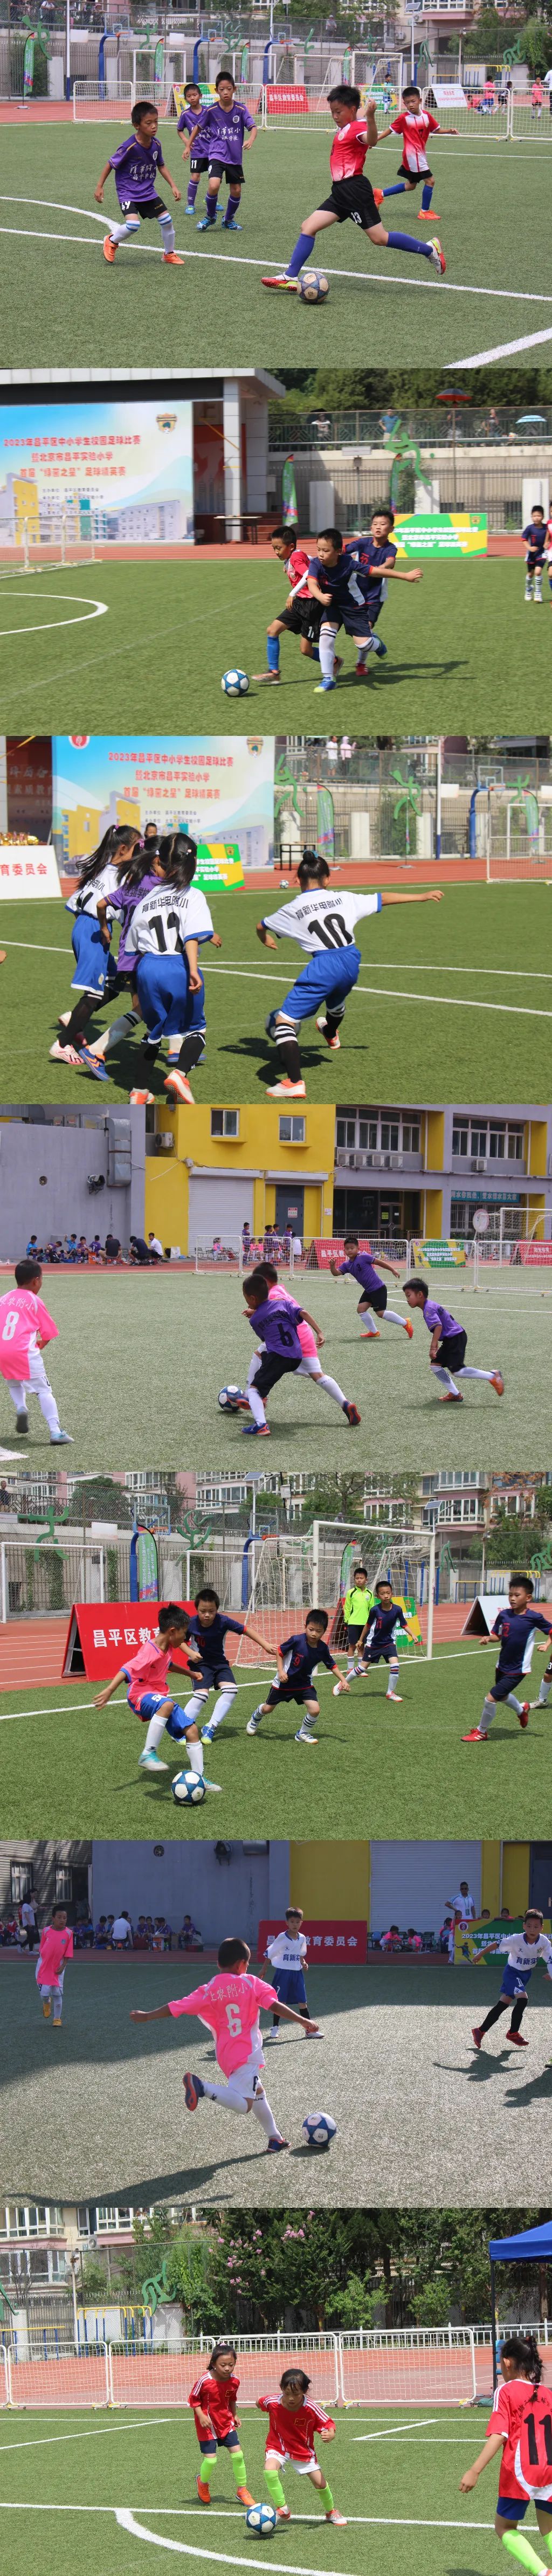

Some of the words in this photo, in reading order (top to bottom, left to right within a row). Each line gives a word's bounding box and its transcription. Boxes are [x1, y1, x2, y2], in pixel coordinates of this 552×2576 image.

[4, 435, 141, 446] 2023年昌平区中小学生校园足球比赛
[108, 752, 234, 767] 2023年昌平区中小学生校园足球比赛
[135, 770, 211, 782] 暨北京市昌平实验小学
[0, 863, 47, 876] 育委员会
[295, 898, 342, 920] 育新华电附小
[307, 913, 353, 949] 10
[2, 1311, 20, 1341] 8
[277, 1323, 294, 1347] 6
[225, 2003, 242, 2037] 6
[523, 2413, 552, 2465] 11
